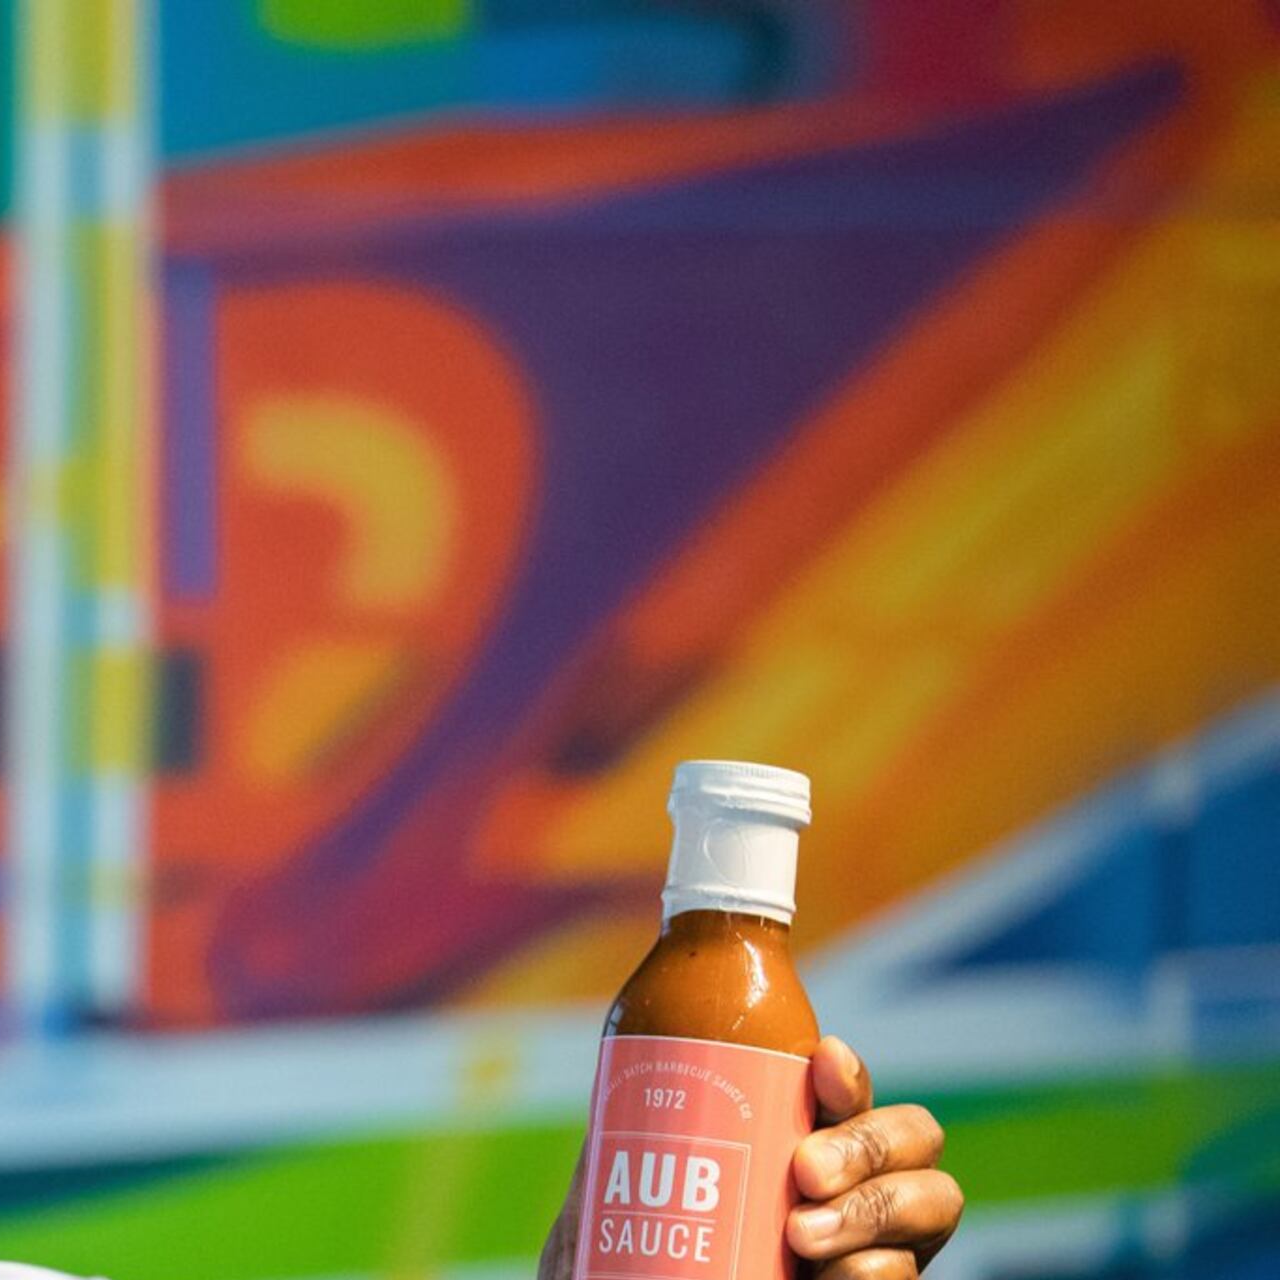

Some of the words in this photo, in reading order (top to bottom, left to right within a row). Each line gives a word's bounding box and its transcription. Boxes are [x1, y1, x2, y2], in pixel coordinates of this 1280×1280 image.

[624, 1062, 653, 1080] BATCH
[655, 1061, 713, 1081] BARBECUE
[712, 1075, 745, 1104] SAUCE
[644, 1088, 687, 1110] 1972
[603, 1150, 721, 1213] AUB
[598, 1218, 715, 1264] SAUCE
